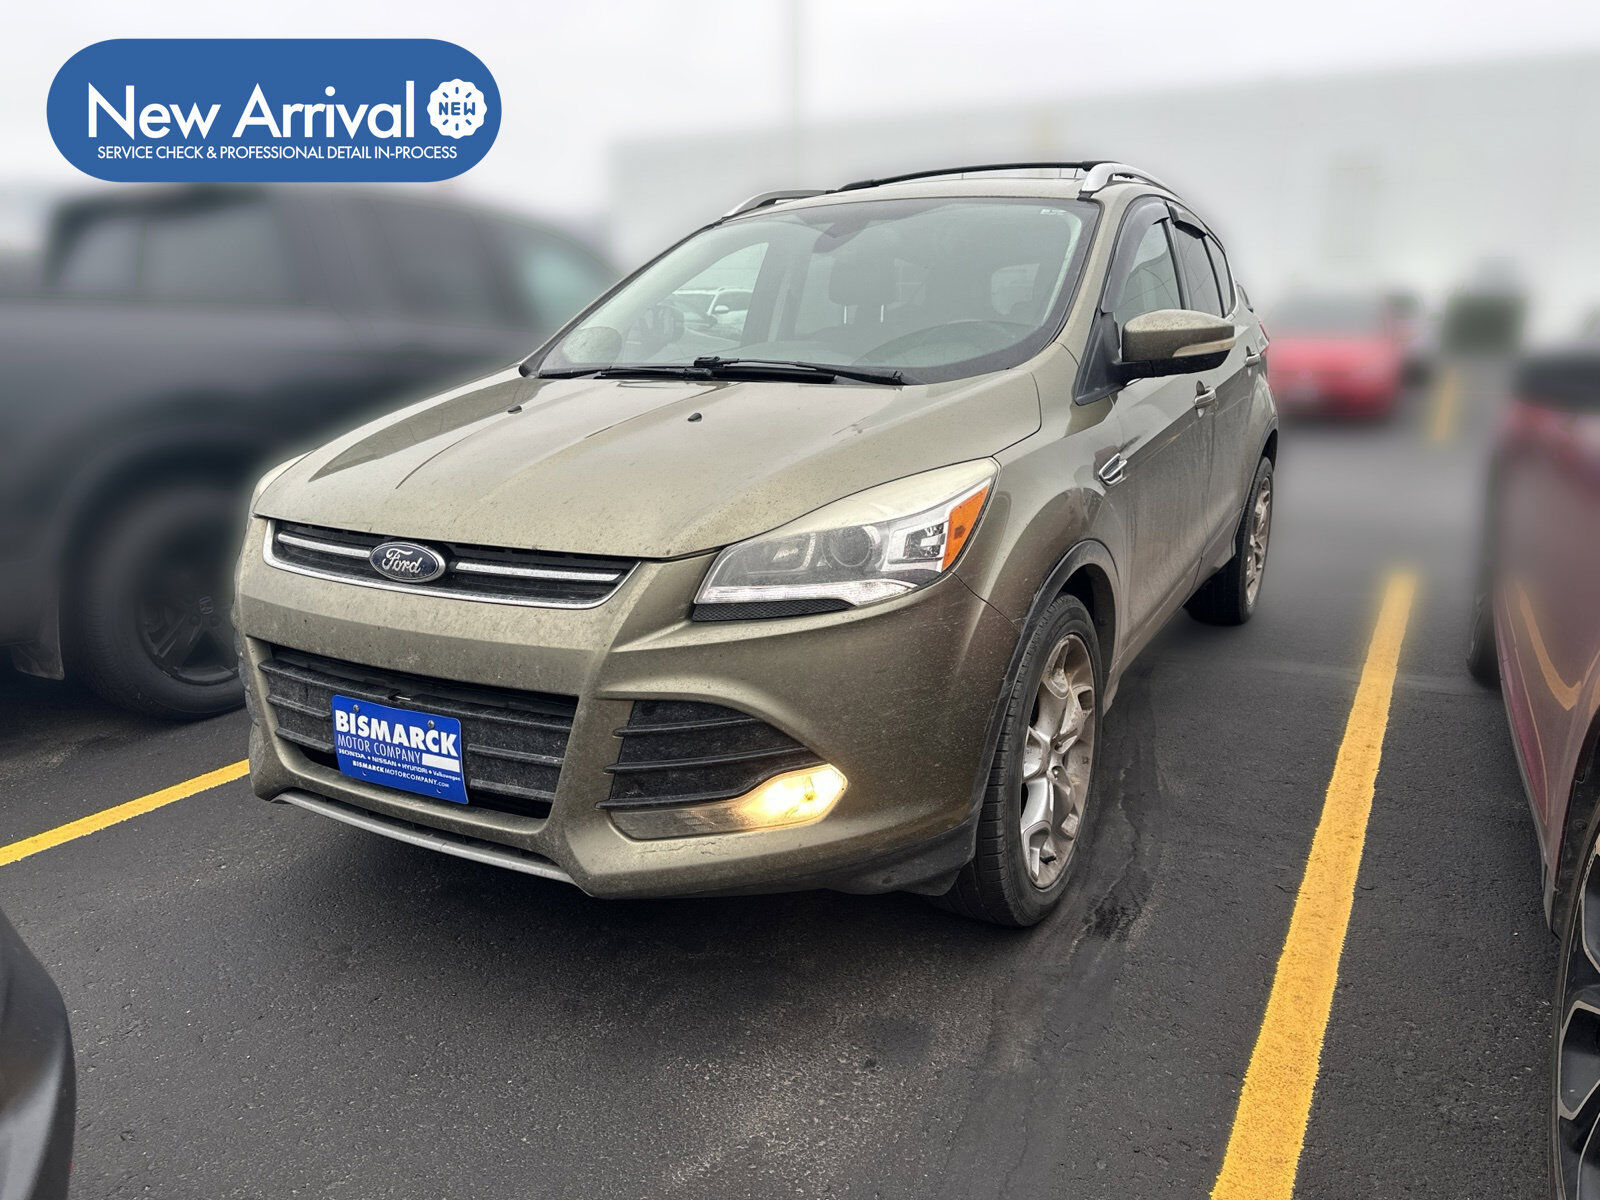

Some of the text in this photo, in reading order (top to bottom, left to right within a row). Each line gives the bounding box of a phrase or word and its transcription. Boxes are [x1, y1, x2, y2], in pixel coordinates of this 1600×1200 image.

[381, 547, 423, 574] Ford
[334, 709, 459, 758] BISMARCK
[337, 733, 421, 764] MOTOR COMPANY
[338, 748, 366, 760] HONDA
[371, 756, 397, 767] NISSAN
[401, 763, 428, 775] HYUNDAI
